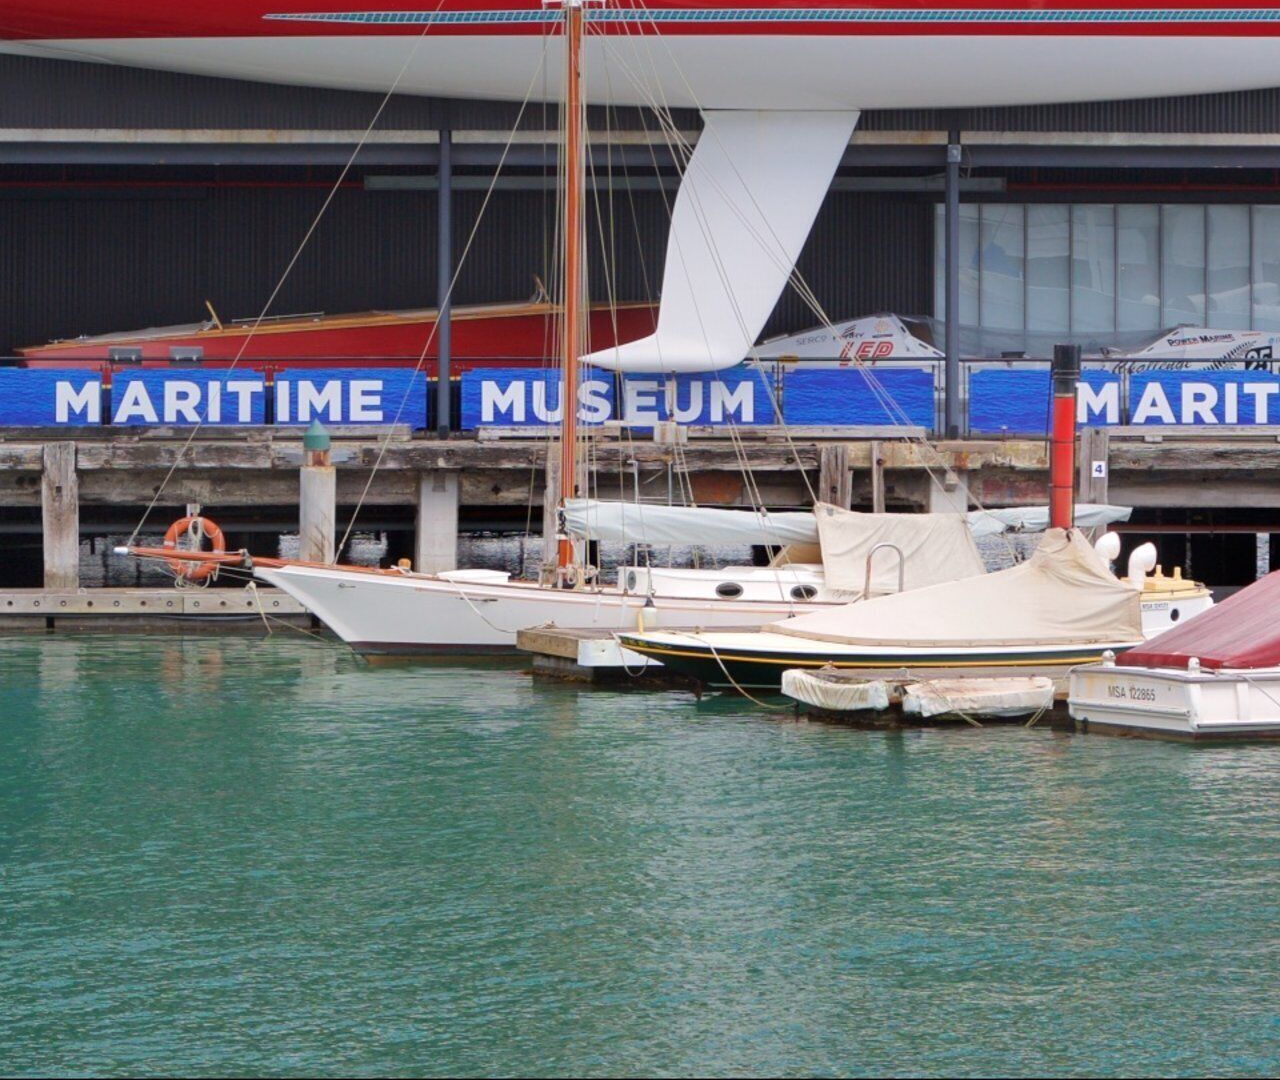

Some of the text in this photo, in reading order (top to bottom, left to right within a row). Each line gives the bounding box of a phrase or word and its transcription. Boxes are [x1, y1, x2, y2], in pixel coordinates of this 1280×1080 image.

[795, 335, 828, 346] SERCO
[1167, 335, 1199, 347] POWER
[1200, 332, 1234, 343] MARINE
[55, 380, 754, 423] MARITIME MUSEUM
[1094, 464, 1103, 475] 4
[1108, 685, 1126, 699] MSA
